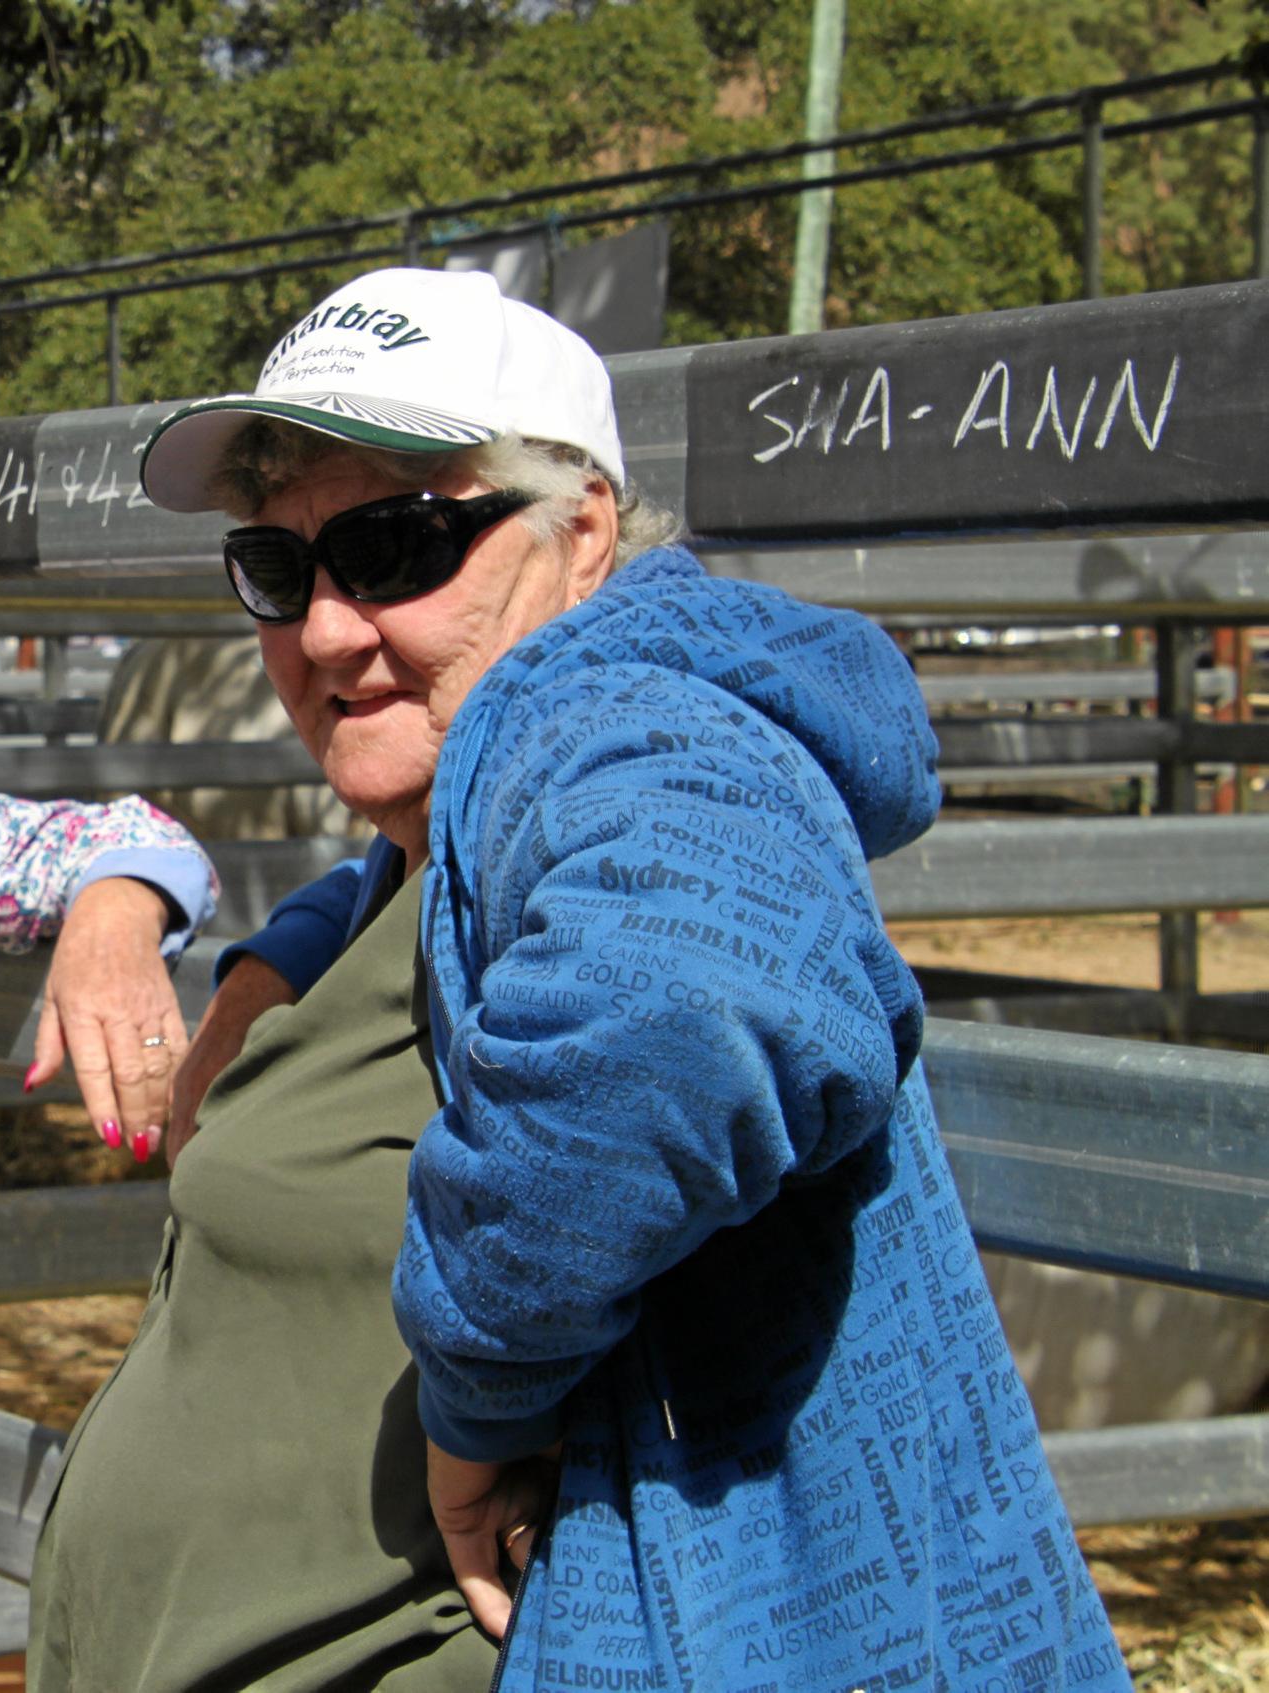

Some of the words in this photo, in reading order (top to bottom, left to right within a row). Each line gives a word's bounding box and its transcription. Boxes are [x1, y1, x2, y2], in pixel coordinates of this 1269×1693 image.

[651, 820, 726, 857] GOLD
[732, 854, 822, 900] COAST
[686, 813, 783, 865] DARWIN
[597, 855, 725, 904] Sydney
[735, 885, 804, 921] HOBART
[597, 944, 681, 974] CAIRNS
[618, 912, 788, 980] BRISBANE
[489, 981, 593, 1012] ADELAIDE
[575, 962, 653, 992] GOLD
[911, 1223, 958, 1352] AUSTRALIA
[860, 1368, 911, 1407] Gold
[955, 1371, 1011, 1516] AUSTRALIA
[857, 1436, 921, 1588] AUSTRALIA
[768, 1557, 890, 1629] MELBOURNE
[743, 1591, 895, 1669] AUSTRALIA
[860, 1623, 925, 1665] Sydney
